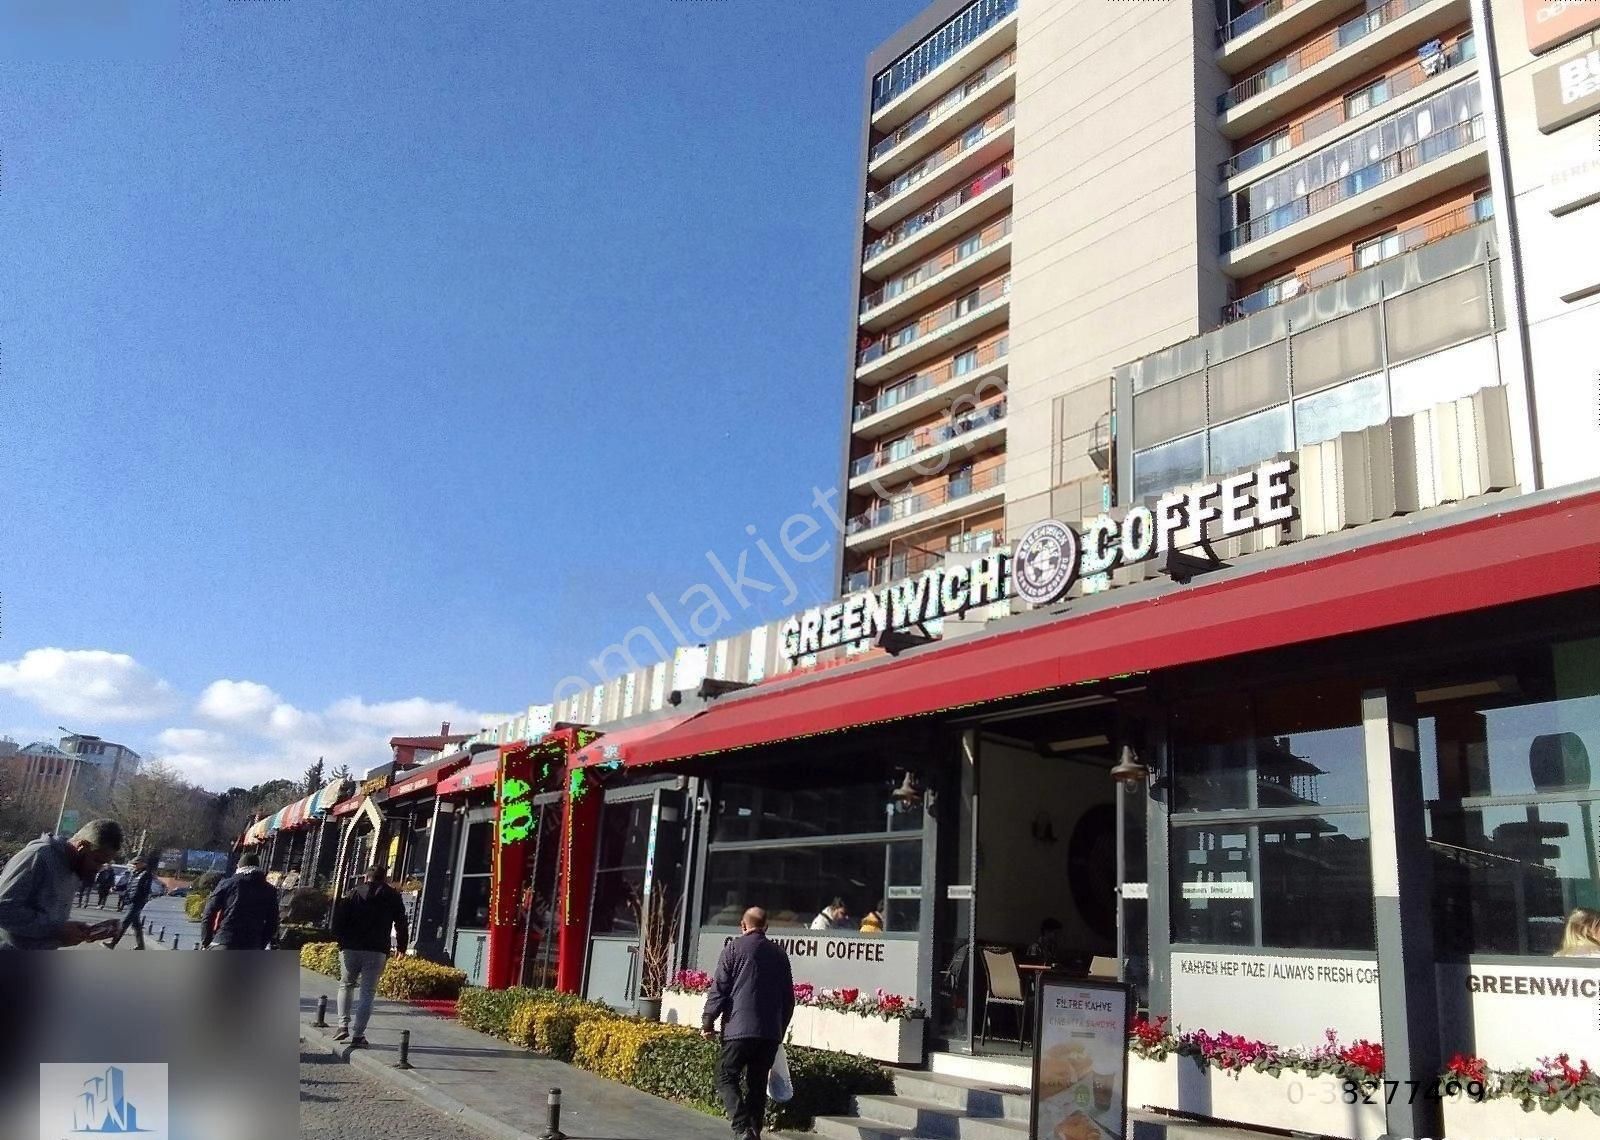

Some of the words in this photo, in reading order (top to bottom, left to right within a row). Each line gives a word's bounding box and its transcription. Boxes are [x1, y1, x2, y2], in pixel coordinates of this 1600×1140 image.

[778, 554, 1001, 659] GREENWICH
[1079, 460, 1293, 574] COFFEE
[826, 940, 885, 962] COFFEE
[1181, 960, 1218, 975] KAHVEN
[1220, 961, 1239, 976] HEP
[1241, 962, 1265, 978] TAZE
[1273, 963, 1315, 981] ALWAYS
[1317, 966, 1353, 983] FRESH
[1466, 974, 1600, 998] GREENWIC
